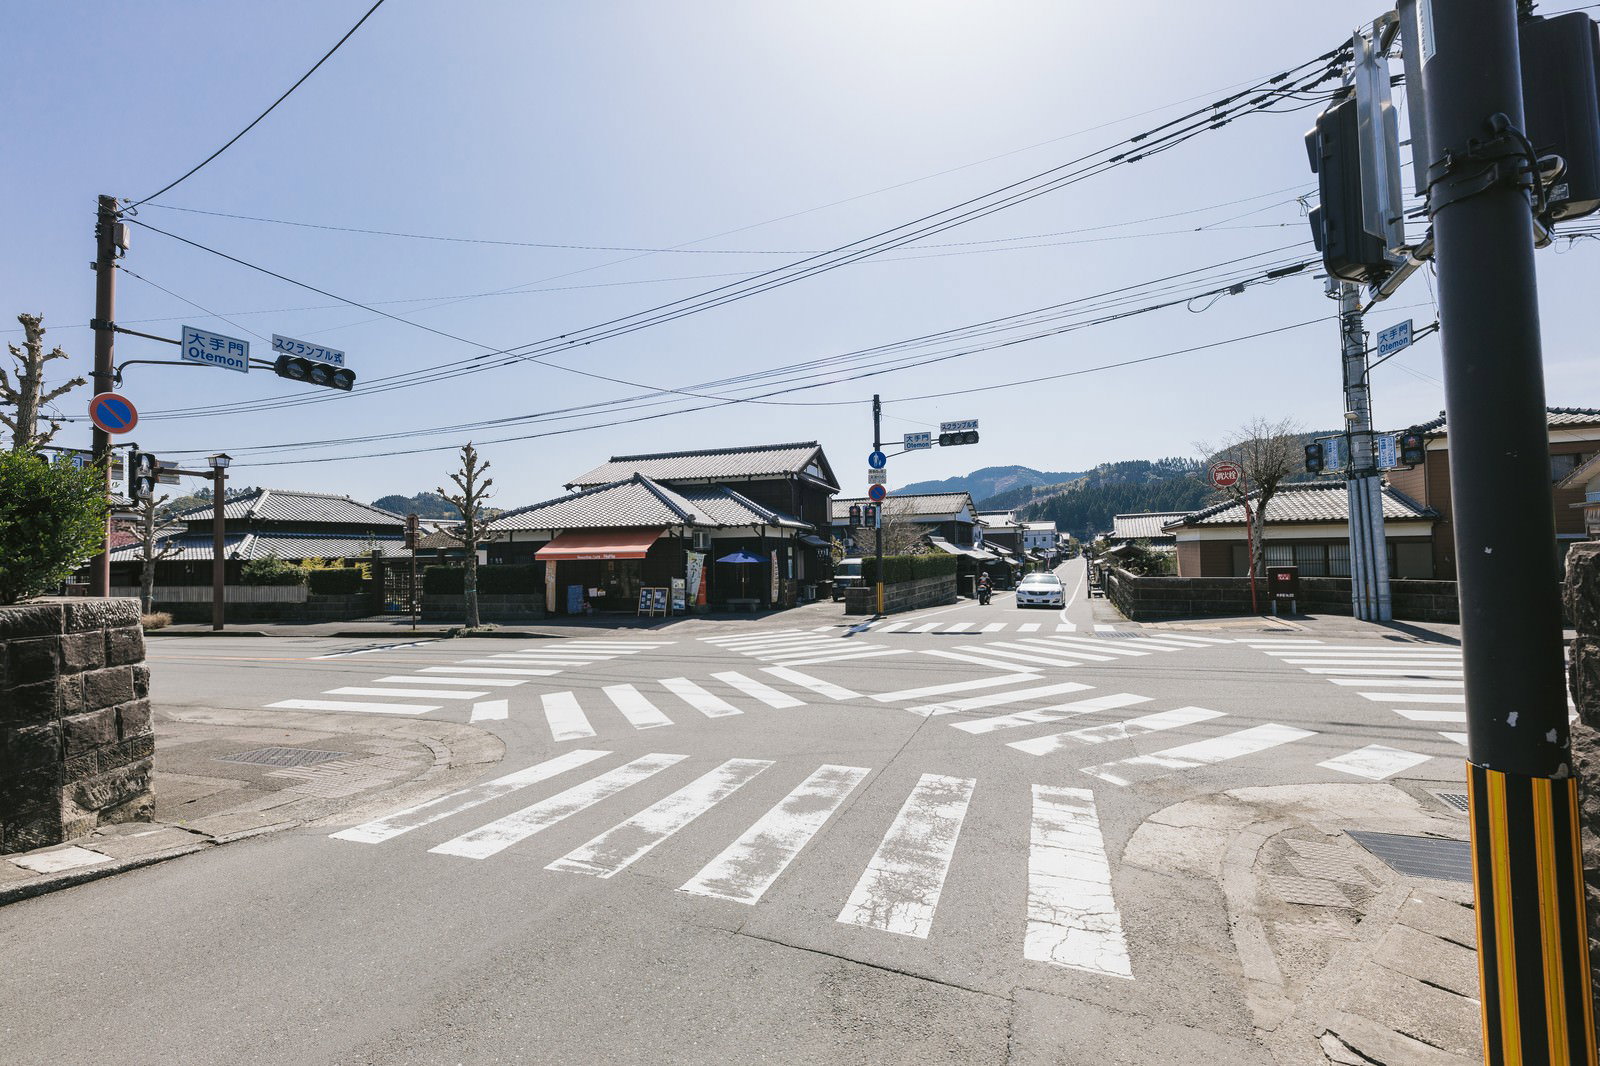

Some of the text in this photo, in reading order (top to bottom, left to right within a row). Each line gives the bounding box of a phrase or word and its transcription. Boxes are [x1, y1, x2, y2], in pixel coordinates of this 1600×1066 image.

[1380, 324, 1408, 344] 大手門
[188, 333, 244, 357] 大手門
[275, 338, 343, 364] スクランブル式
[1380, 337, 1408, 353] Otemon
[188, 346, 243, 368] Otemon
[941, 420, 977, 430] スクランブル式
[906, 434, 929, 442] 大手門
[1215, 471, 1237, 480] 消火栓
